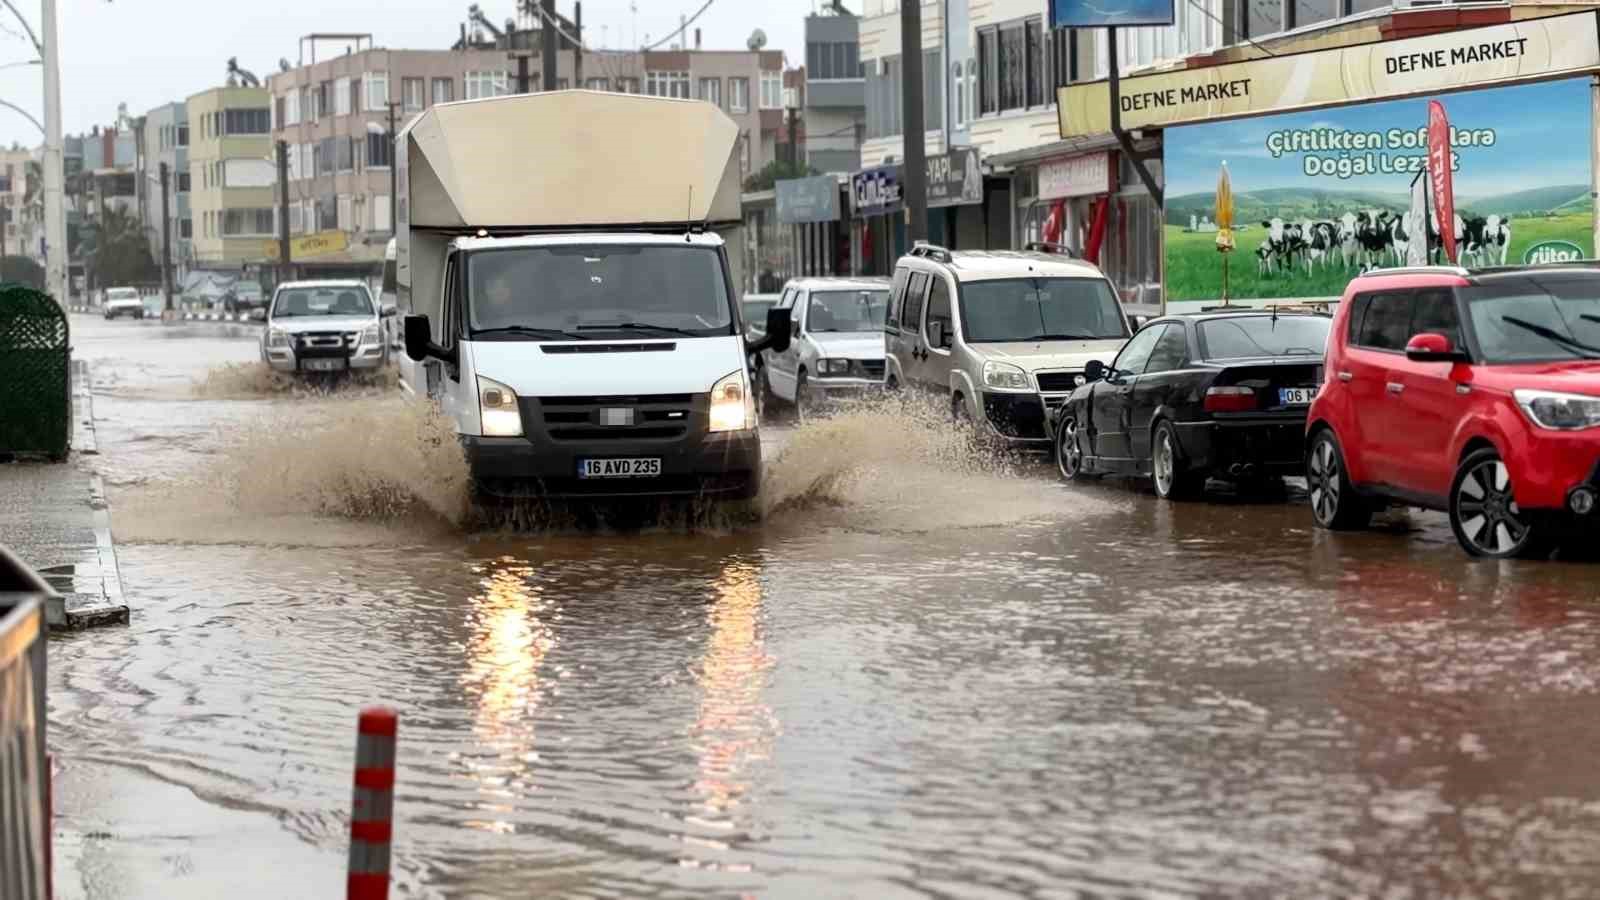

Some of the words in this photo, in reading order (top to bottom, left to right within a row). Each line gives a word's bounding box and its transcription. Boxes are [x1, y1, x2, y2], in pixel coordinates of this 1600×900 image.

[1385, 50, 1446, 75] DEFNE
[1450, 38, 1528, 65] MARKET
[1121, 89, 1177, 112] DEFNE
[1181, 79, 1252, 104] MARKET
[1267, 128, 1382, 157] Çiftlikten
[1387, 127, 1496, 149] Soflara
[1304, 153, 1376, 179] Doğal
[1379, 152, 1460, 174] Lezt
[1286, 390, 1303, 402] 06
[586, 460, 601, 474] 16
[604, 460, 630, 474] AVD
[633, 460, 658, 473] 235
